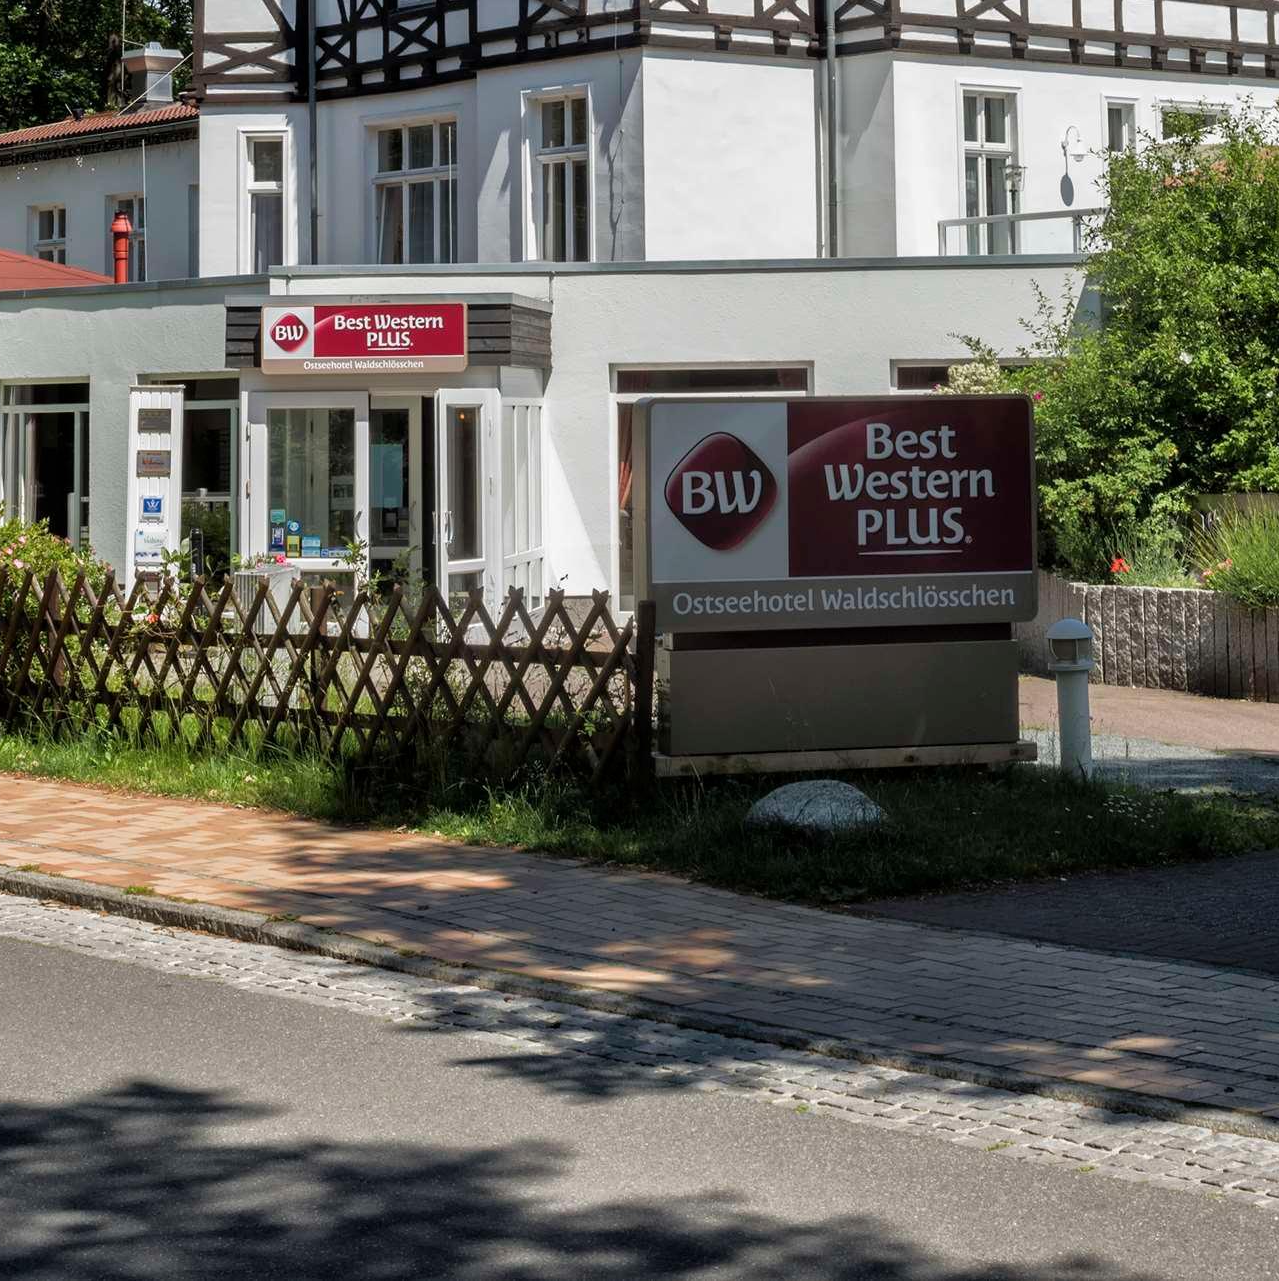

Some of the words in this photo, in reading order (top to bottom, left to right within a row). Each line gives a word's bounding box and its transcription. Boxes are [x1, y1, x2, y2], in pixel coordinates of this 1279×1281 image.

[275, 325, 304, 341] BW
[334, 315, 372, 330] Best
[374, 314, 444, 330] Western
[366, 331, 411, 347] PLUS
[303, 361, 353, 370] Ostseehotel
[354, 359, 424, 369] Waldschlösschen
[866, 422, 958, 461] Best
[681, 469, 763, 515] BW
[824, 463, 996, 502] Western
[857, 506, 965, 546] PLUS
[672, 588, 815, 616] Ostseehotel
[821, 583, 1016, 613] Waldschlösschen
